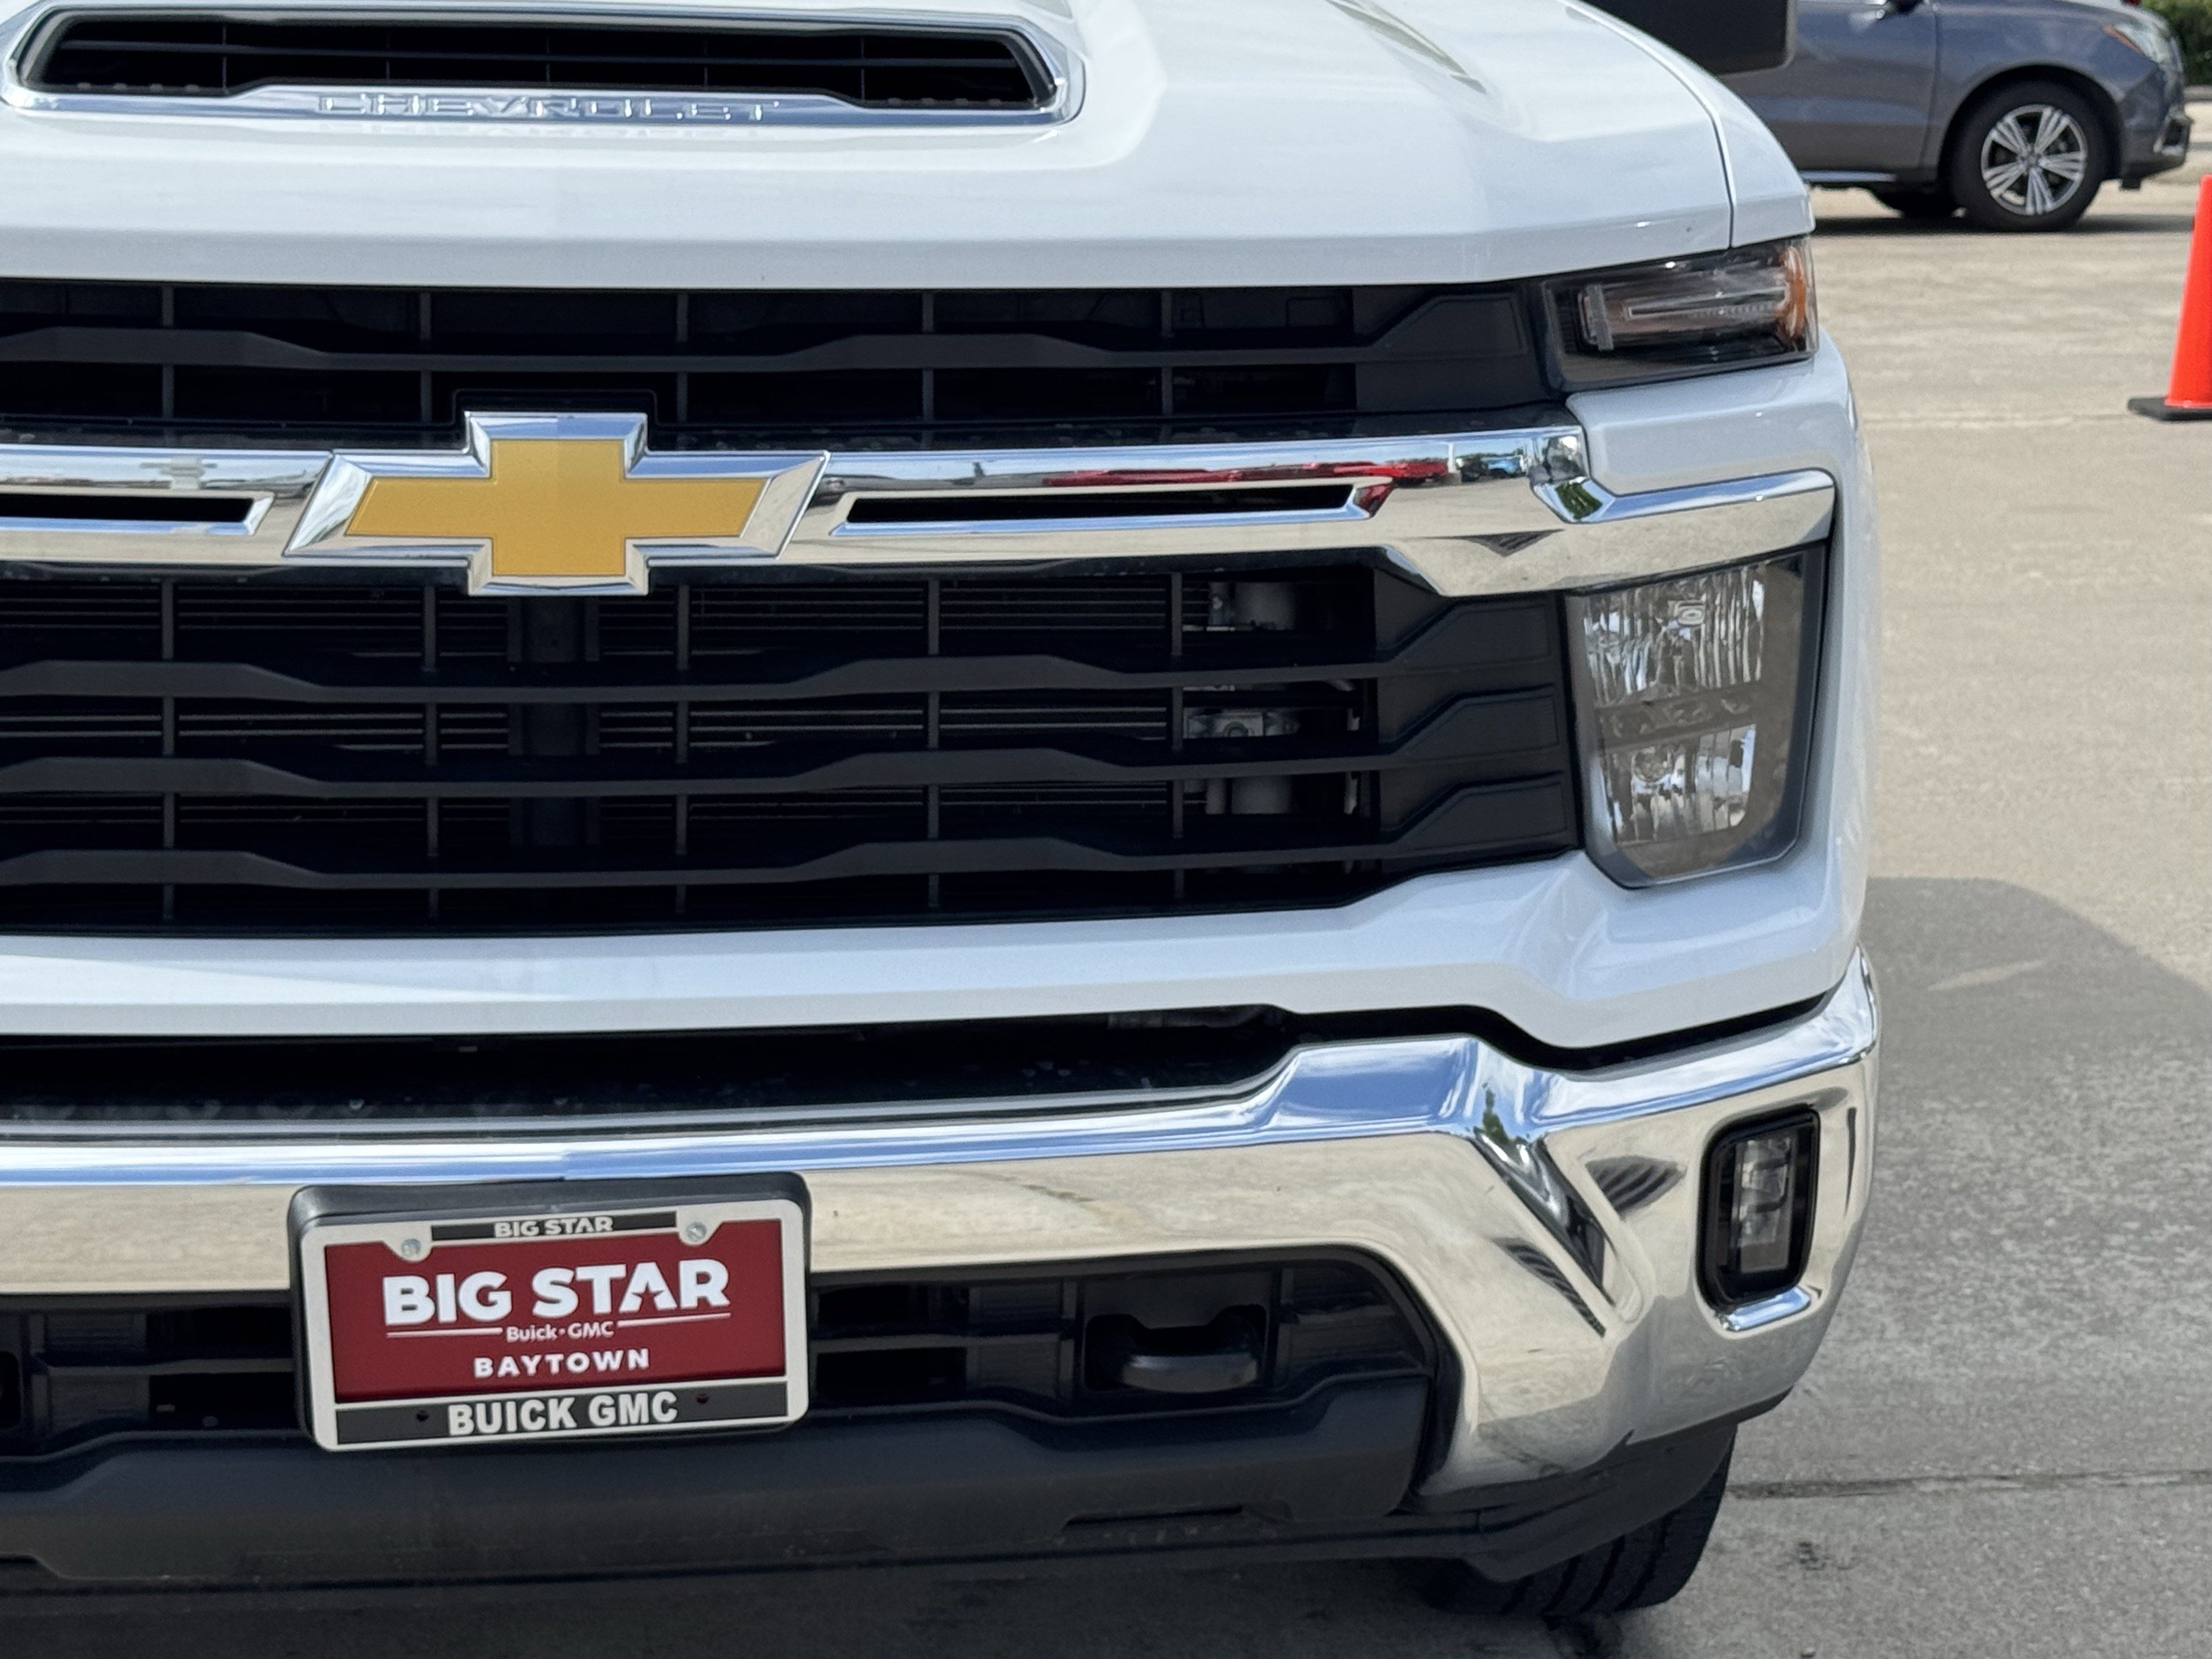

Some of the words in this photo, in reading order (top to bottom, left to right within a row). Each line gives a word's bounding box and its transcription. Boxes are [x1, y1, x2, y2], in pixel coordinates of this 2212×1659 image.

[318, 93, 781, 121] CHEVROLET
[494, 1220, 540, 1238] BIG
[544, 1216, 613, 1237] STAR
[383, 1271, 512, 1326] BIG
[533, 1259, 730, 1316] STAR
[475, 1348, 649, 1378] BAYTOWN
[448, 1397, 577, 1436] BUICK
[589, 1392, 678, 1426] GMC
